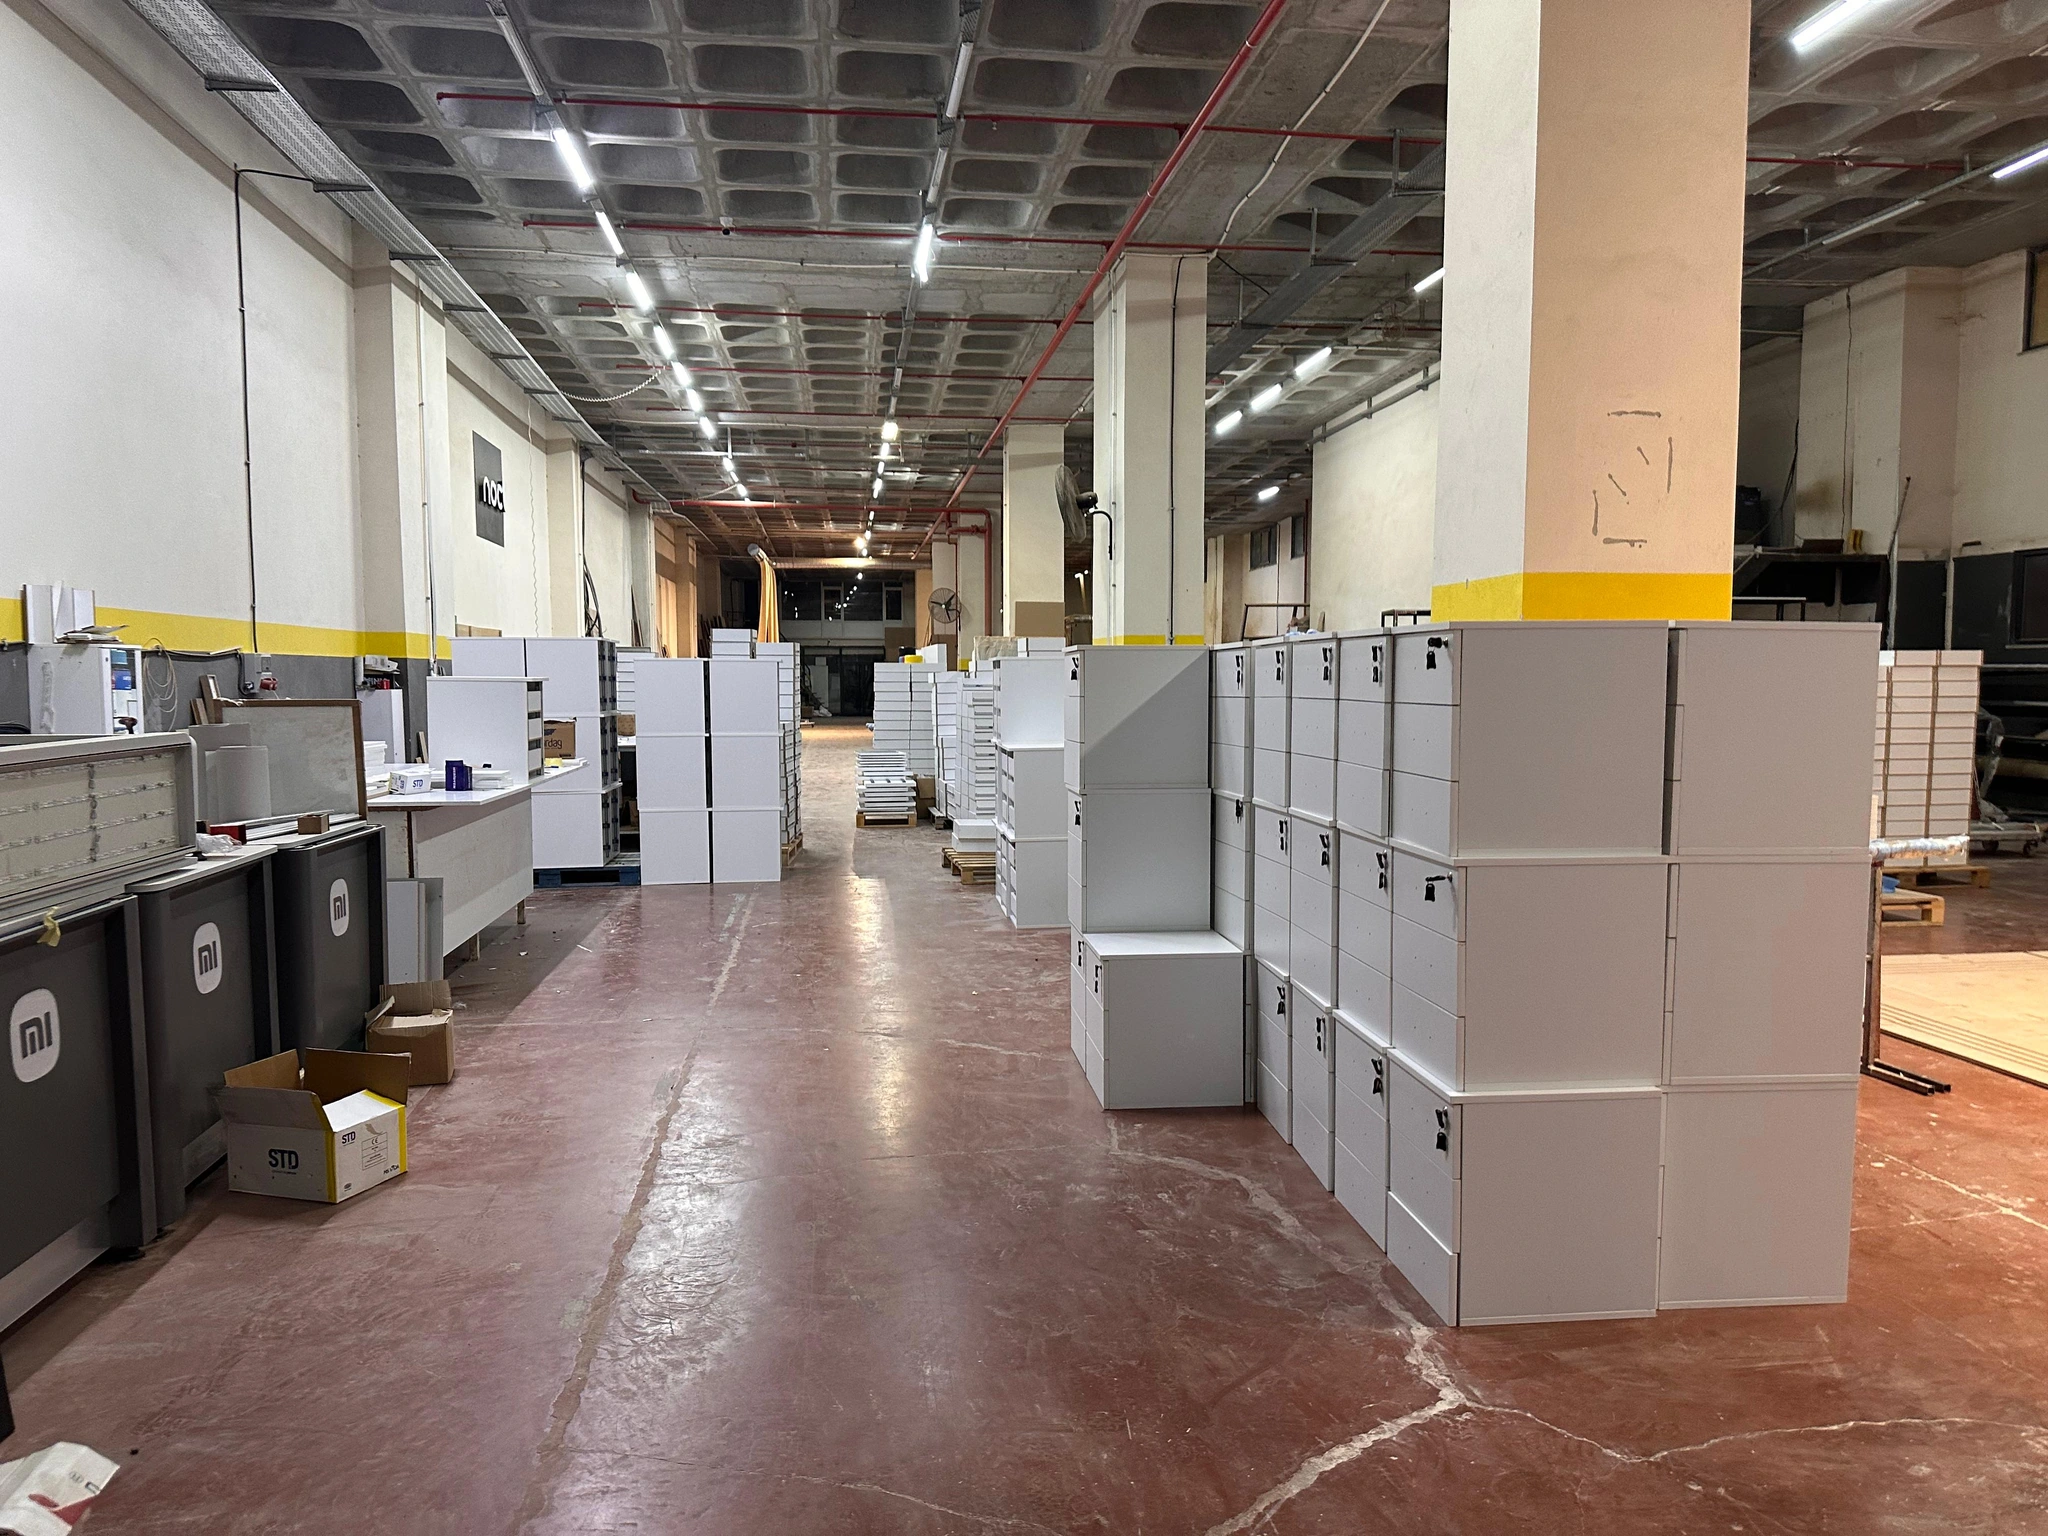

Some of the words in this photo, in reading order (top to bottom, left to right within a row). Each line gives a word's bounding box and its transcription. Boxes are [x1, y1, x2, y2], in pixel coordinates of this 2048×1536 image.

[544, 737, 563, 750] rdag
[412, 779, 424, 788] STD
[341, 1131, 356, 1145] STD
[268, 1148, 299, 1170] STD
